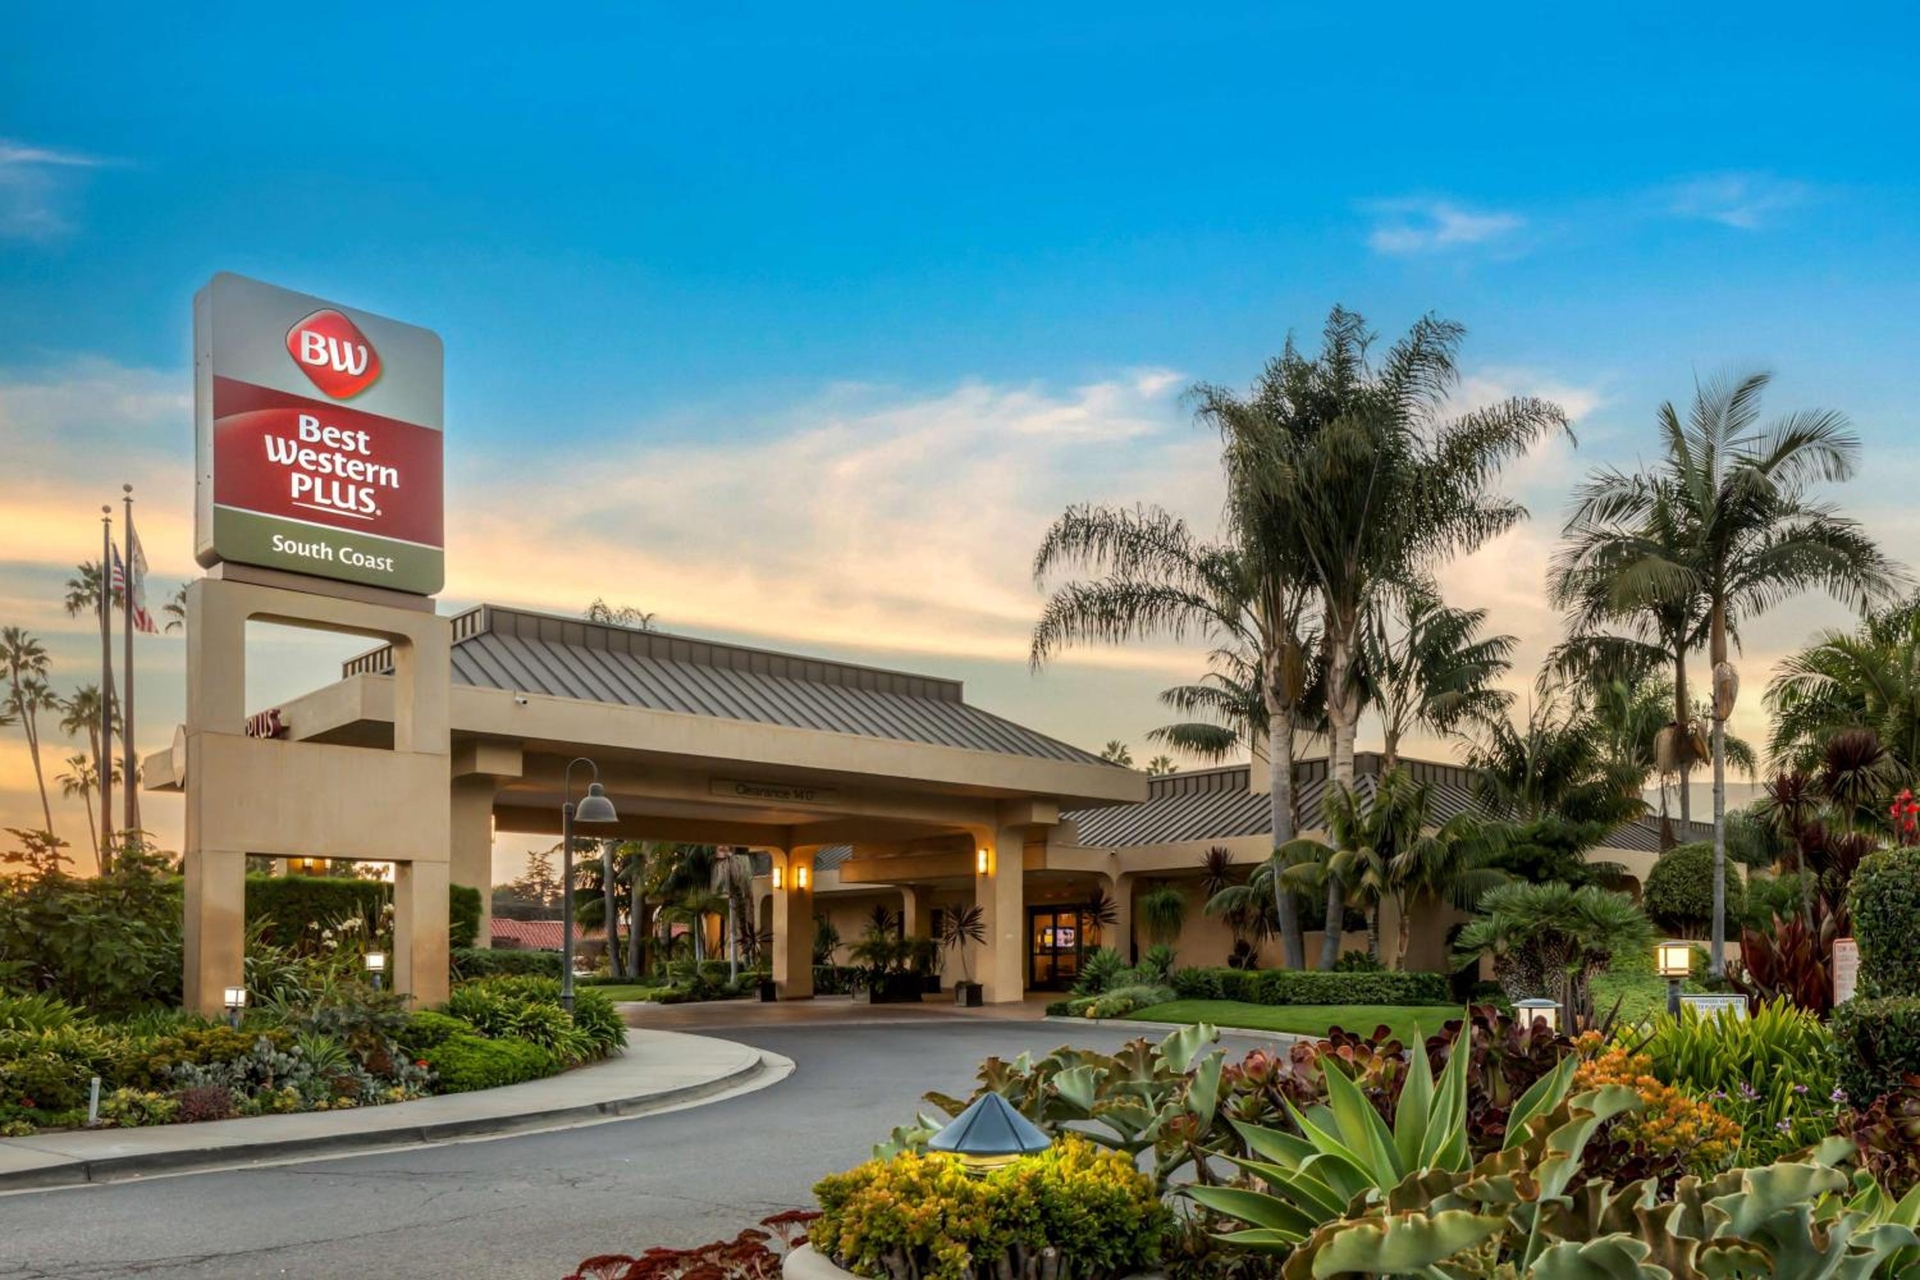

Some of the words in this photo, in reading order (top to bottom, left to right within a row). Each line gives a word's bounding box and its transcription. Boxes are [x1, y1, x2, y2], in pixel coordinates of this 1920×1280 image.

[301, 329, 369, 376] BW
[298, 414, 371, 456] Best
[264, 434, 400, 488] Western
[272, 534, 334, 561] South
[338, 547, 395, 573] Coast
[246, 709, 275, 739] PLUS
[735, 783, 791, 800] Clearance
